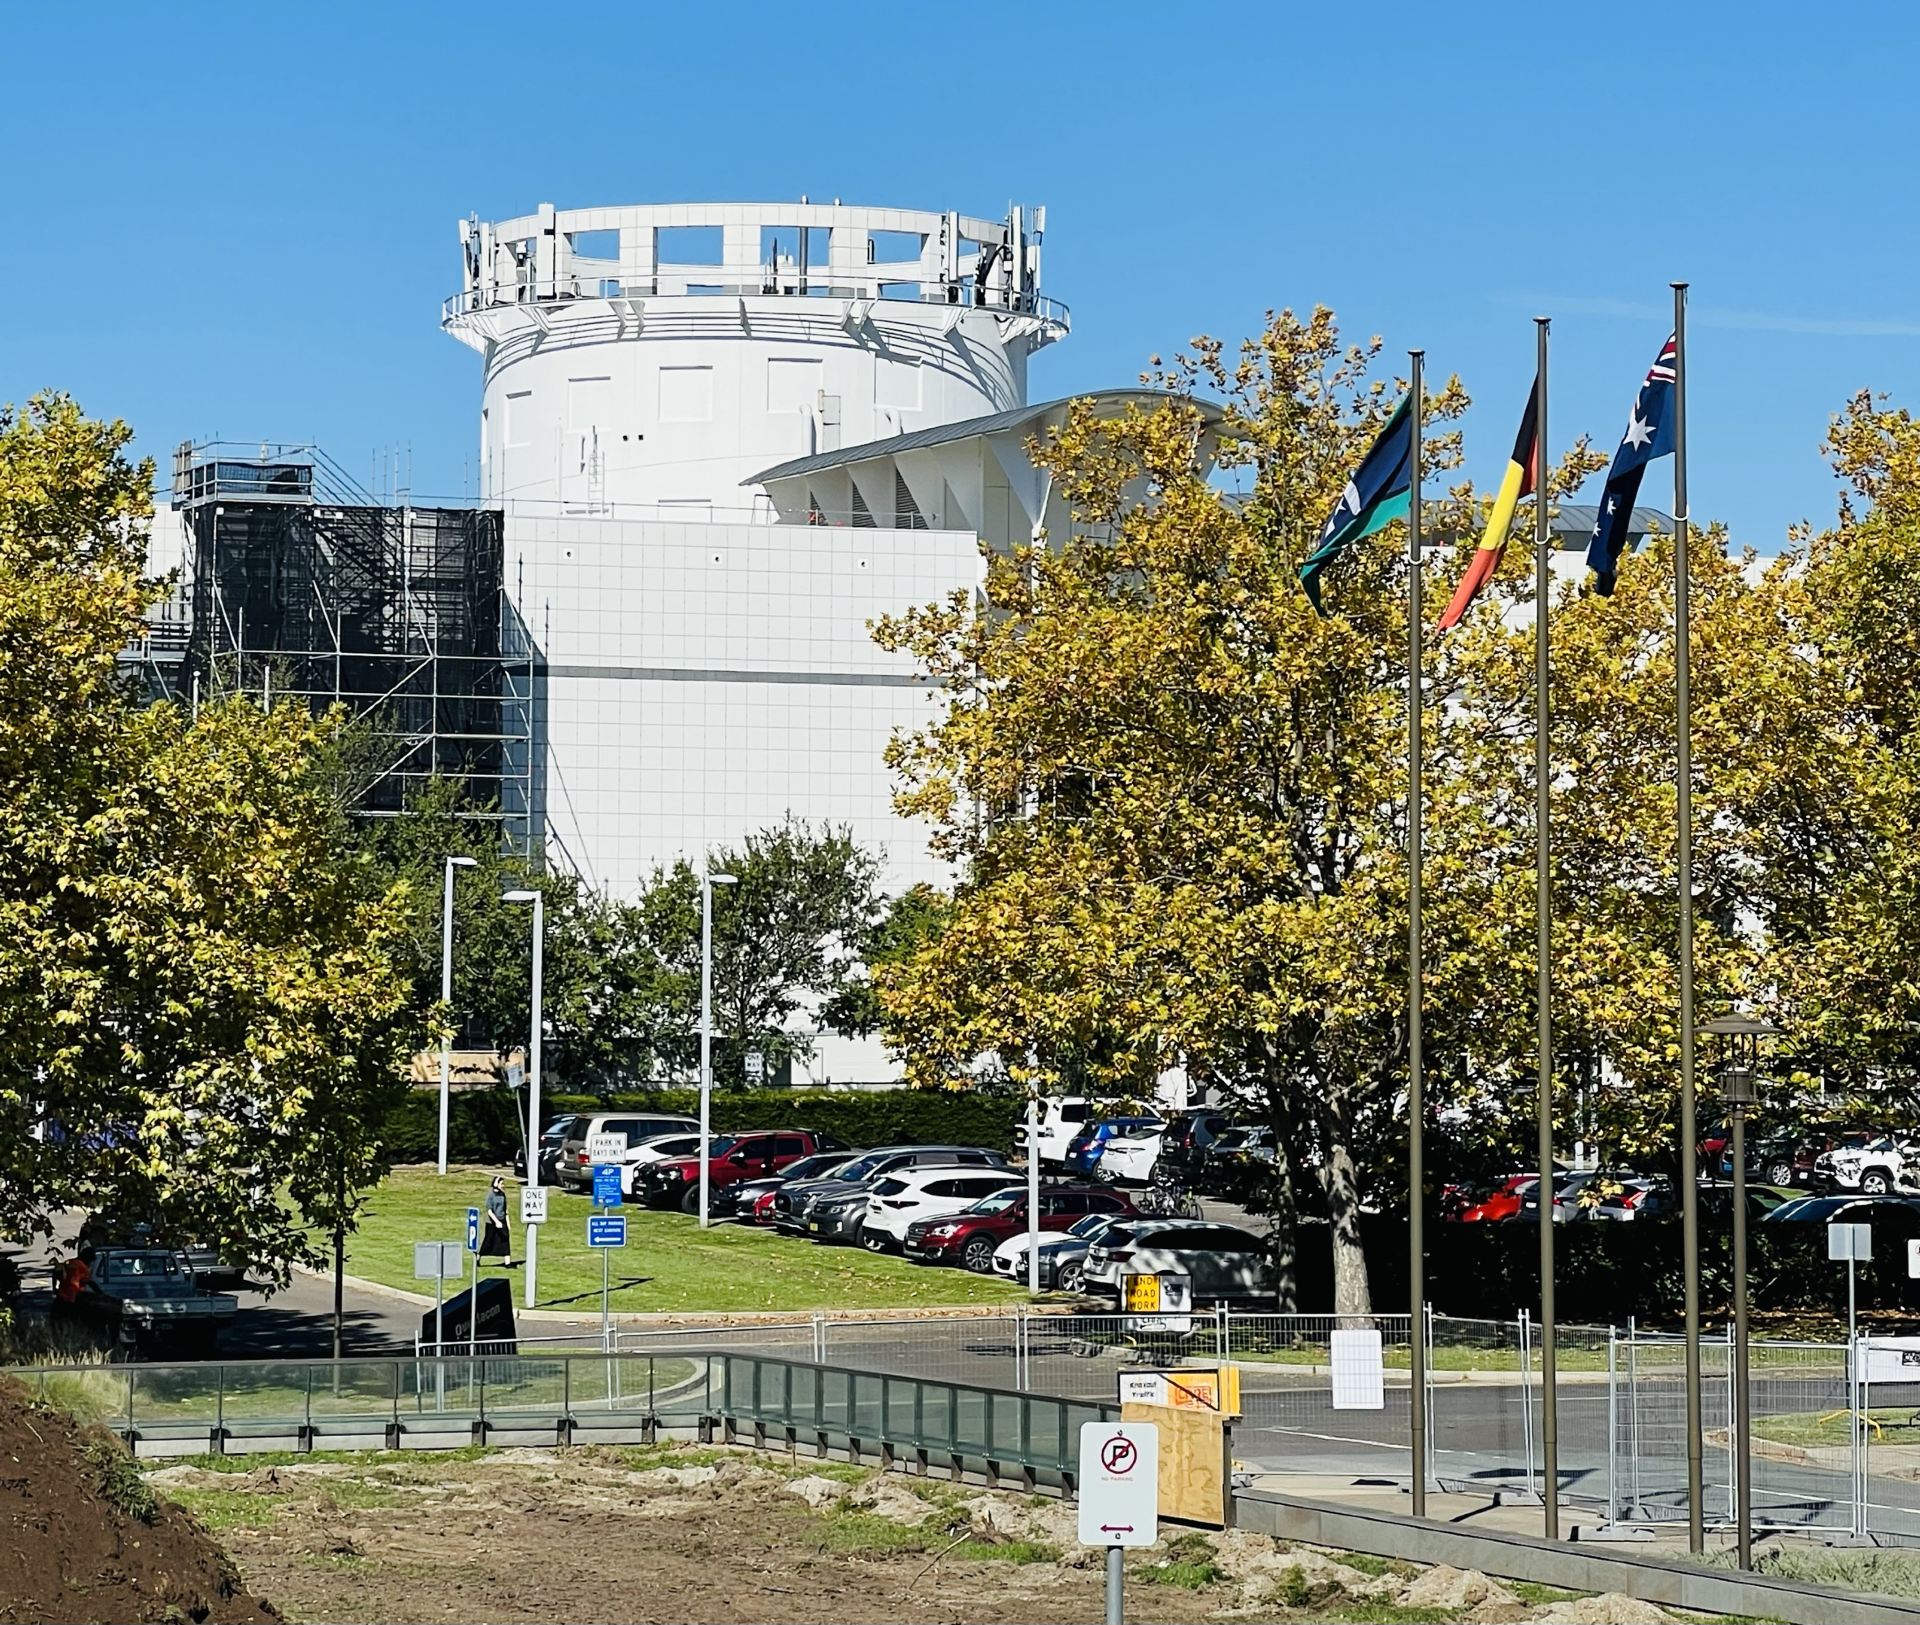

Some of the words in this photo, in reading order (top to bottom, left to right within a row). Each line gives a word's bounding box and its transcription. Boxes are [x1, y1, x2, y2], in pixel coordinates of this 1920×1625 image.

[525, 1191, 543, 1199] ONE
[525, 1201, 543, 1209] WAY
[469, 1225, 476, 1248] P
[1134, 1277, 1153, 1285] END
[1130, 1289, 1156, 1298] ROAD
[1130, 1301, 1156, 1310] WORK
